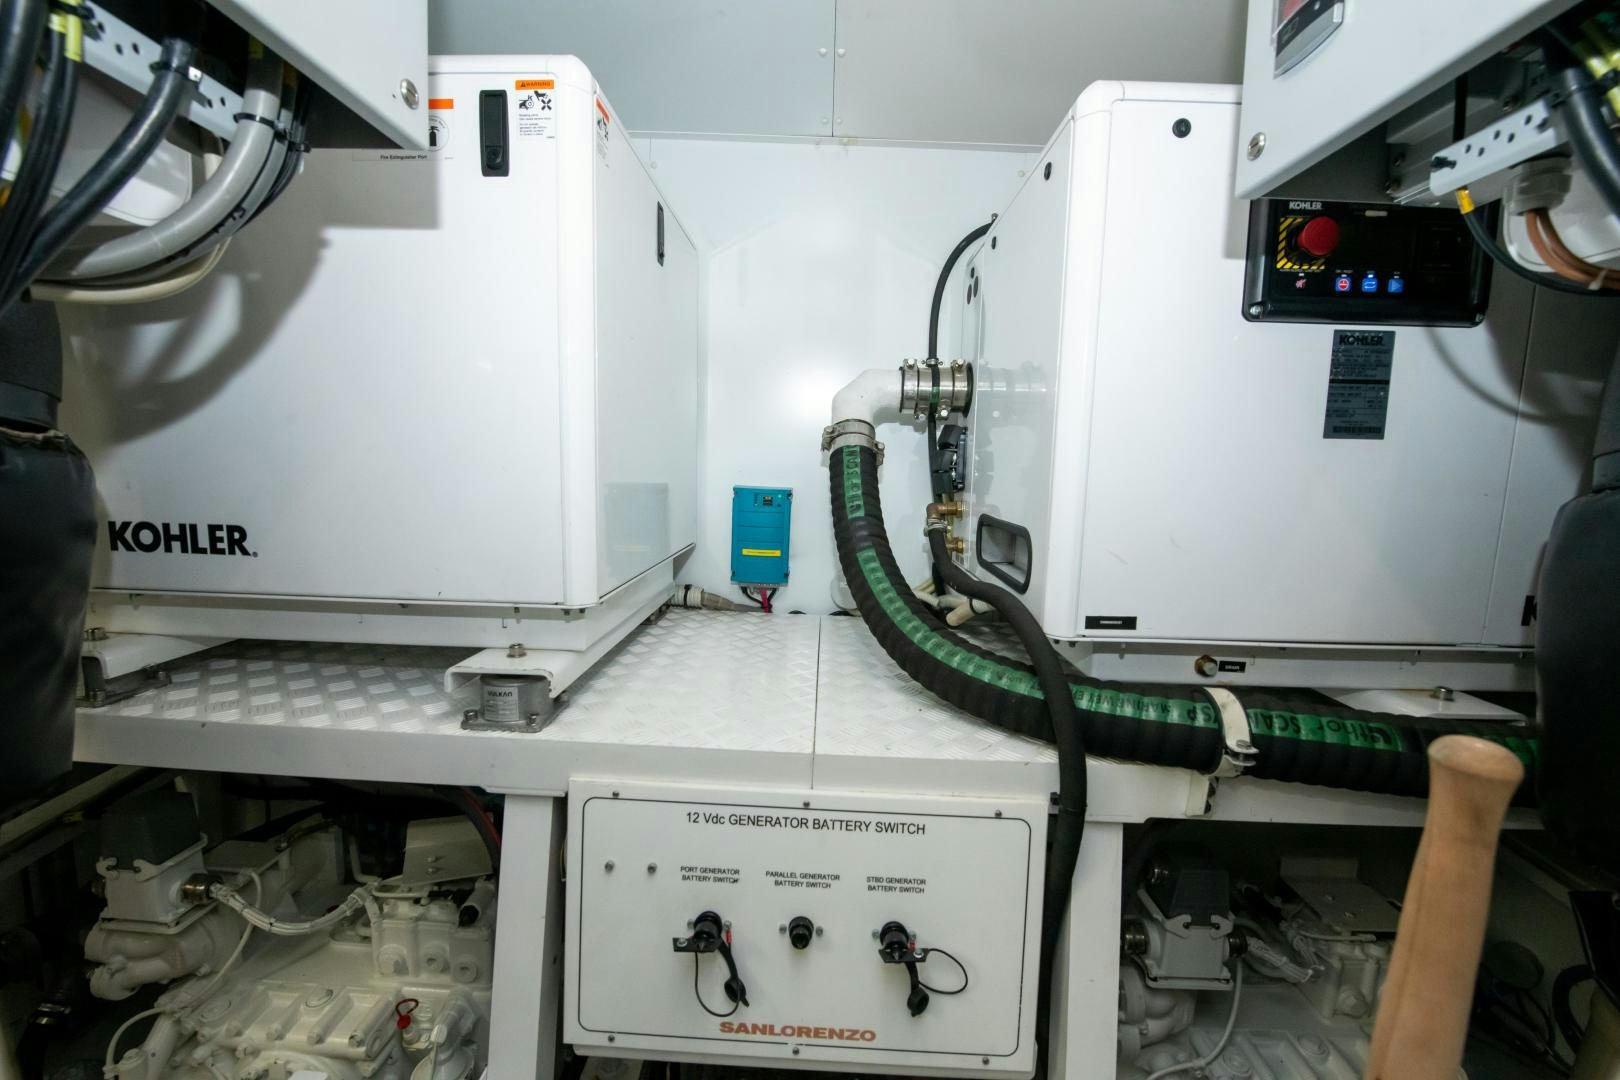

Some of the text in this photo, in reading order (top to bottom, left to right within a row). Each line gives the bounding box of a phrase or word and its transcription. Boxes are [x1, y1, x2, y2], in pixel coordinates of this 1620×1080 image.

[1289, 200, 1323, 210] KOHLER
[1339, 334, 1384, 346] KOHLER
[107, 520, 252, 556] KOHLER
[686, 812, 926, 835] 12 Vdc GENERATOR BATTERY SWITCH
[680, 865, 740, 875] PORT GENERATOR
[681, 874, 740, 884] BATTERY SWITCH
[765, 870, 841, 881] PARALLEL GENERATOR
[774, 879, 832, 889] BATTERY SWITCH
[866, 876, 927, 886] STBD GENERATOR
[867, 884, 925, 894] BATTERY SWITCH
[719, 1021, 877, 1042] SANLORENZO
